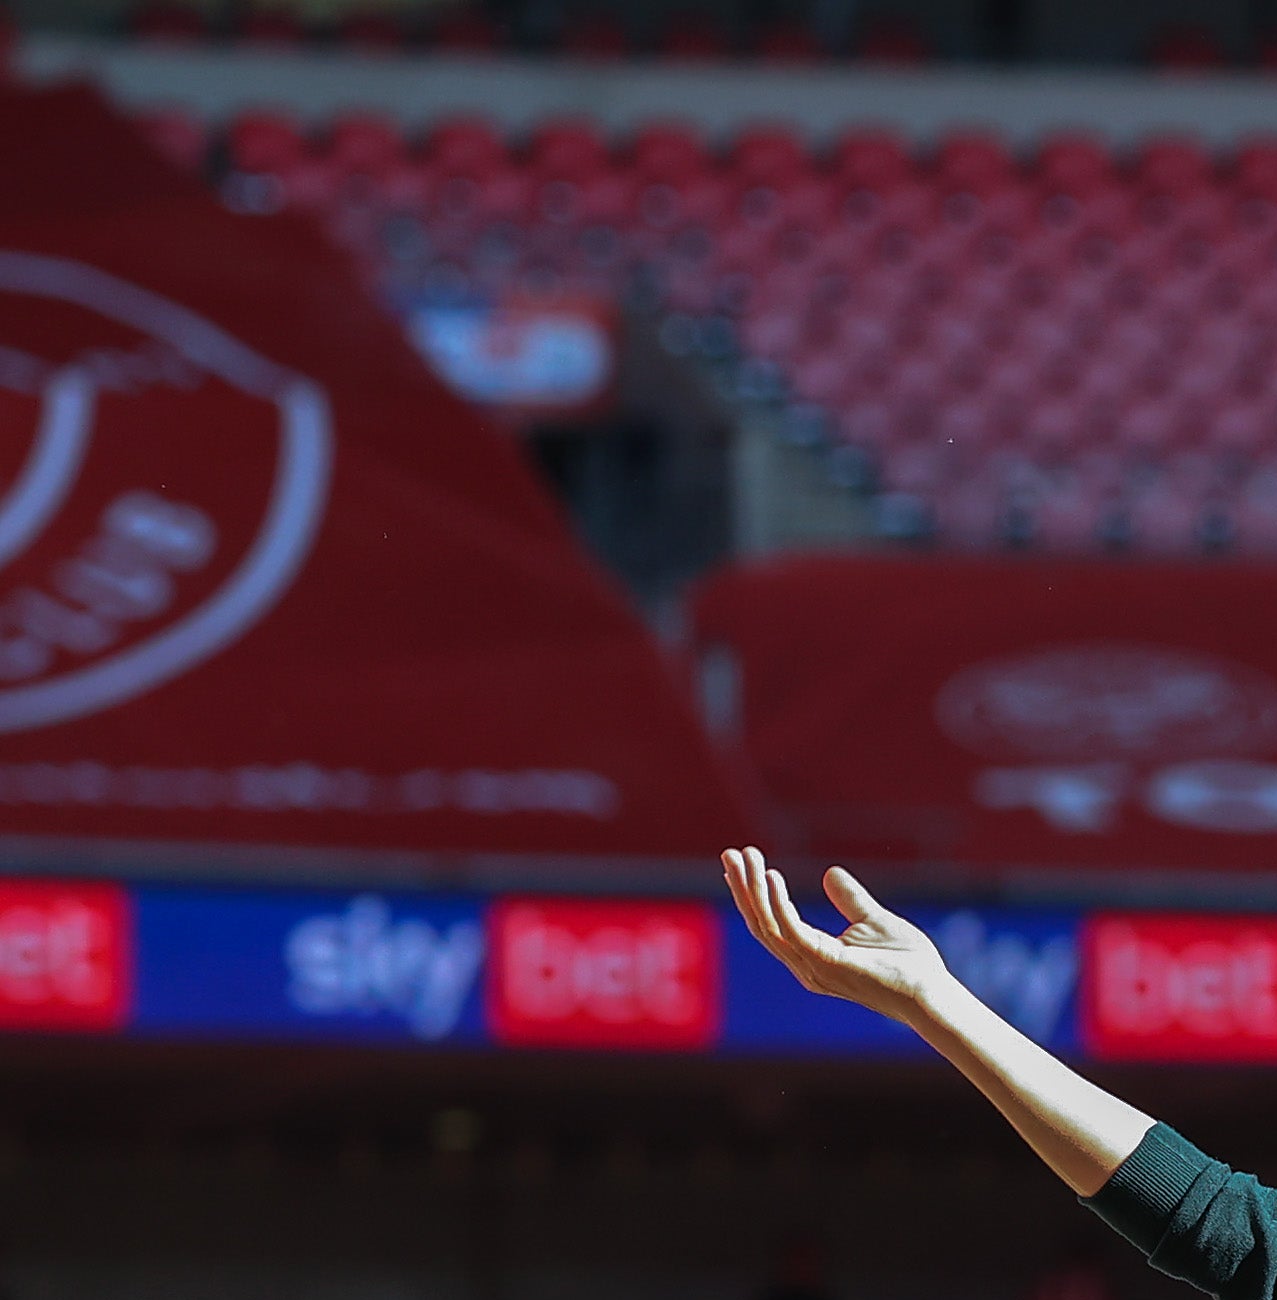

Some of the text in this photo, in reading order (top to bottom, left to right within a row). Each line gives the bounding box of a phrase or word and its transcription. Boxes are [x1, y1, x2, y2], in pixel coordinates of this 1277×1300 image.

[0, 896, 97, 1018] et
[287, 896, 692, 1038] sky bet
